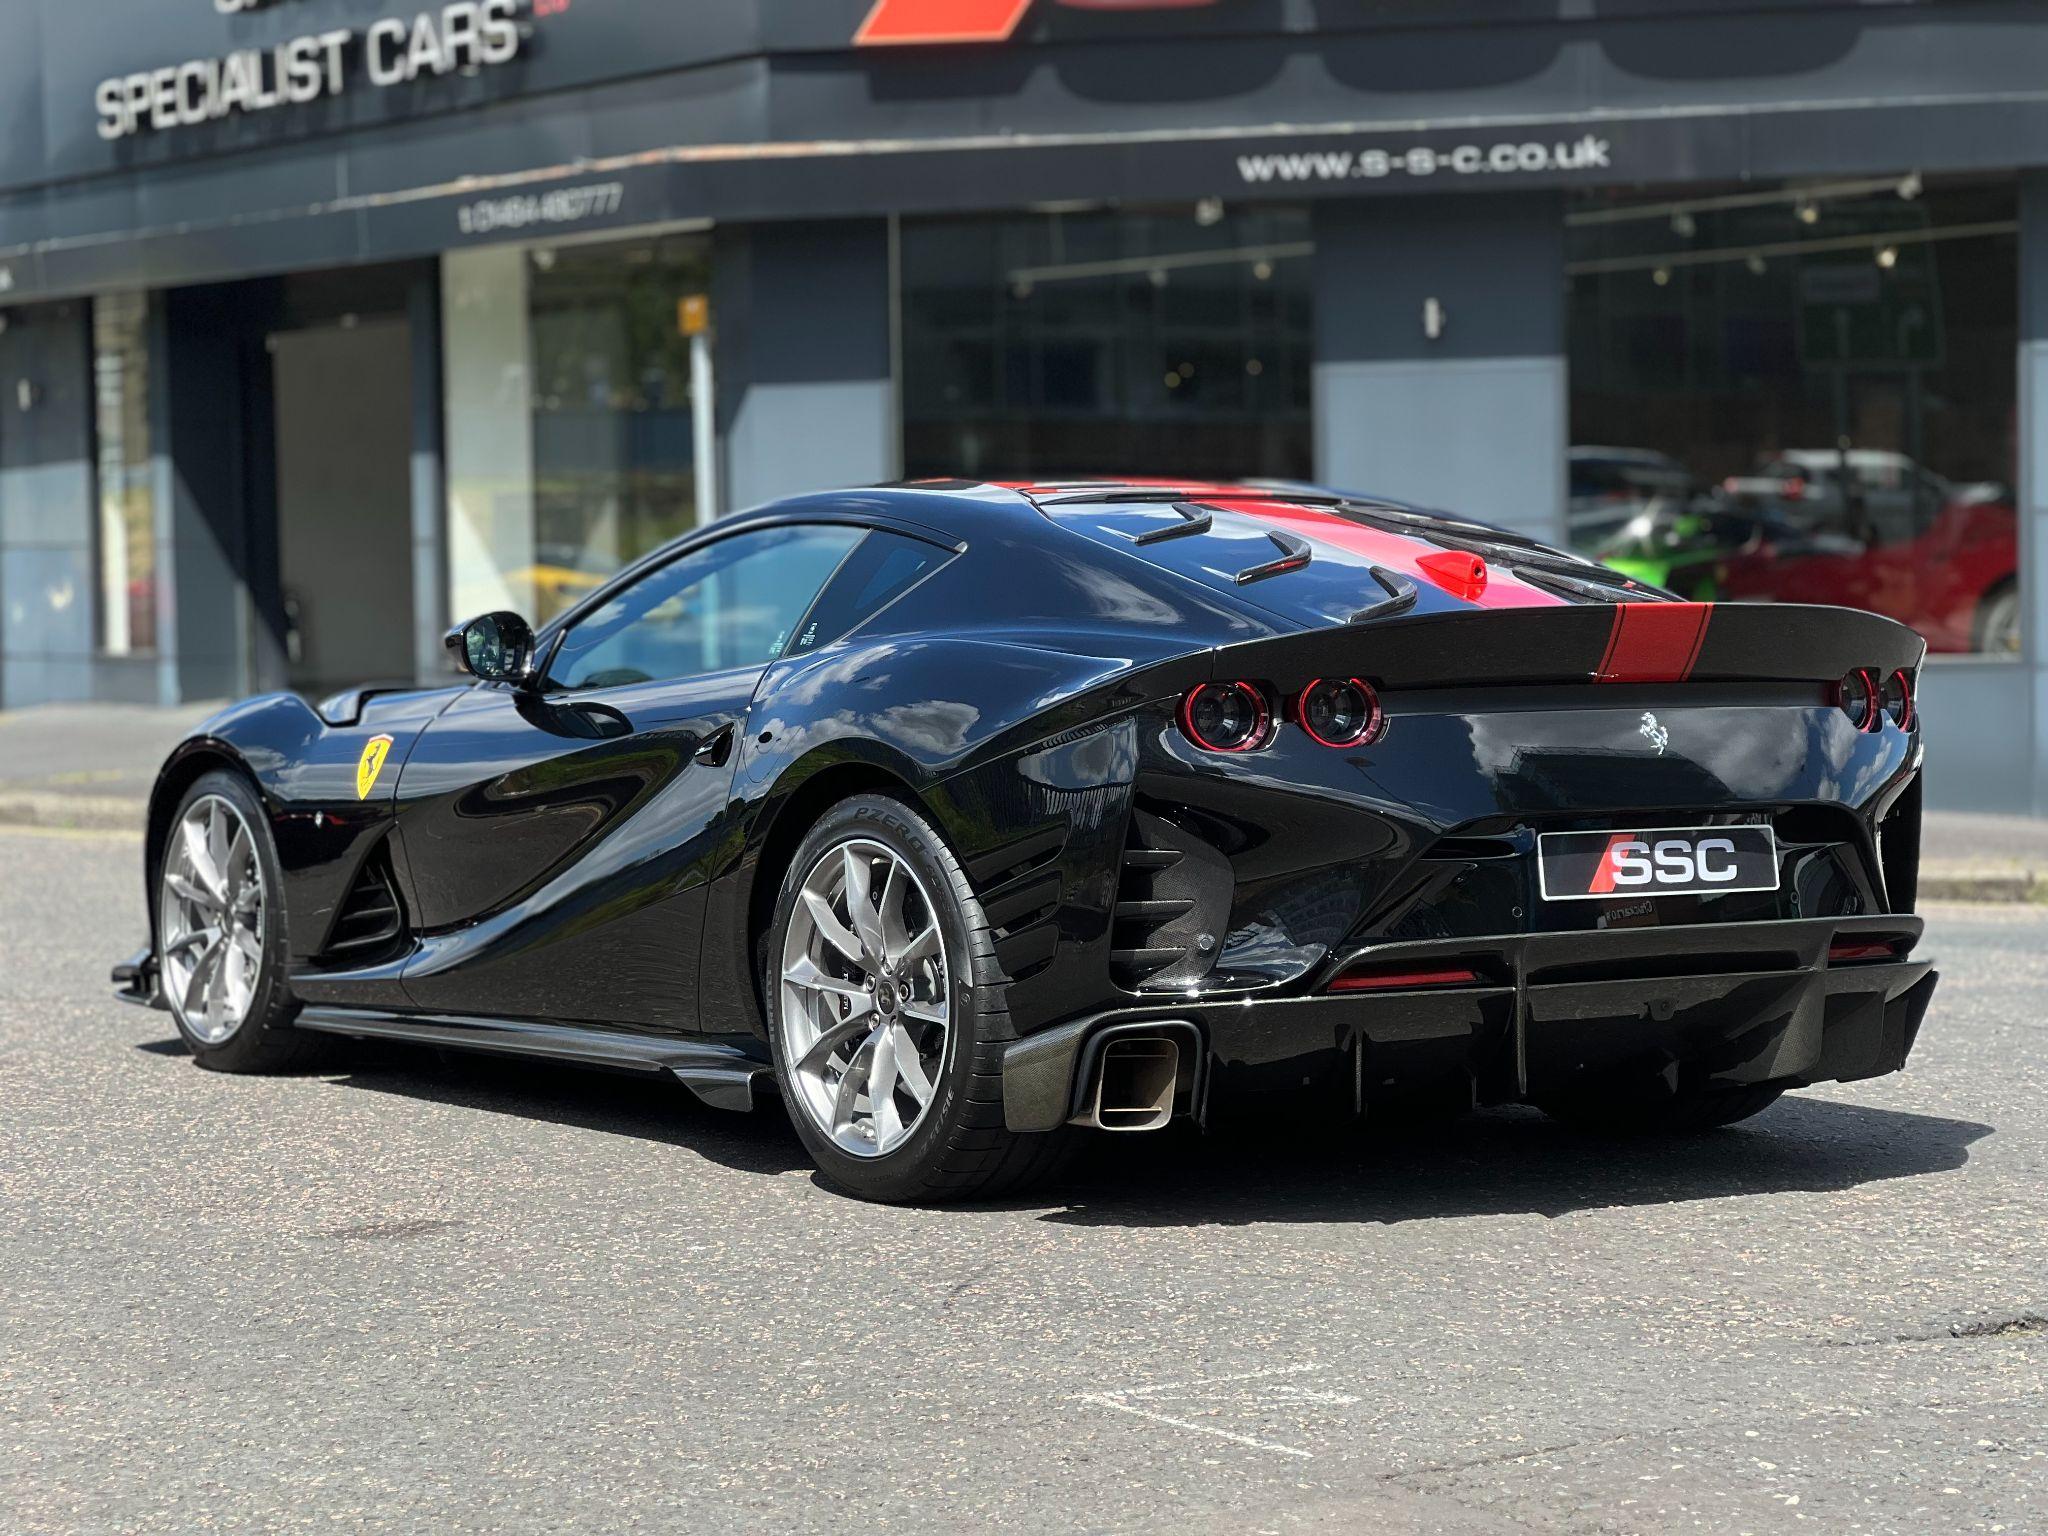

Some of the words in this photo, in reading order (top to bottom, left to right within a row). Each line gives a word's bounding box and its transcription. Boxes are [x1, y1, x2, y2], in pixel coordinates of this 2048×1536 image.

[95, 28, 352, 140] SPECIALIST
[366, 0, 519, 87] CARS
[1236, 133, 1611, 183] www.s-s-c.co.uk
[1610, 838, 1739, 886] SSC
